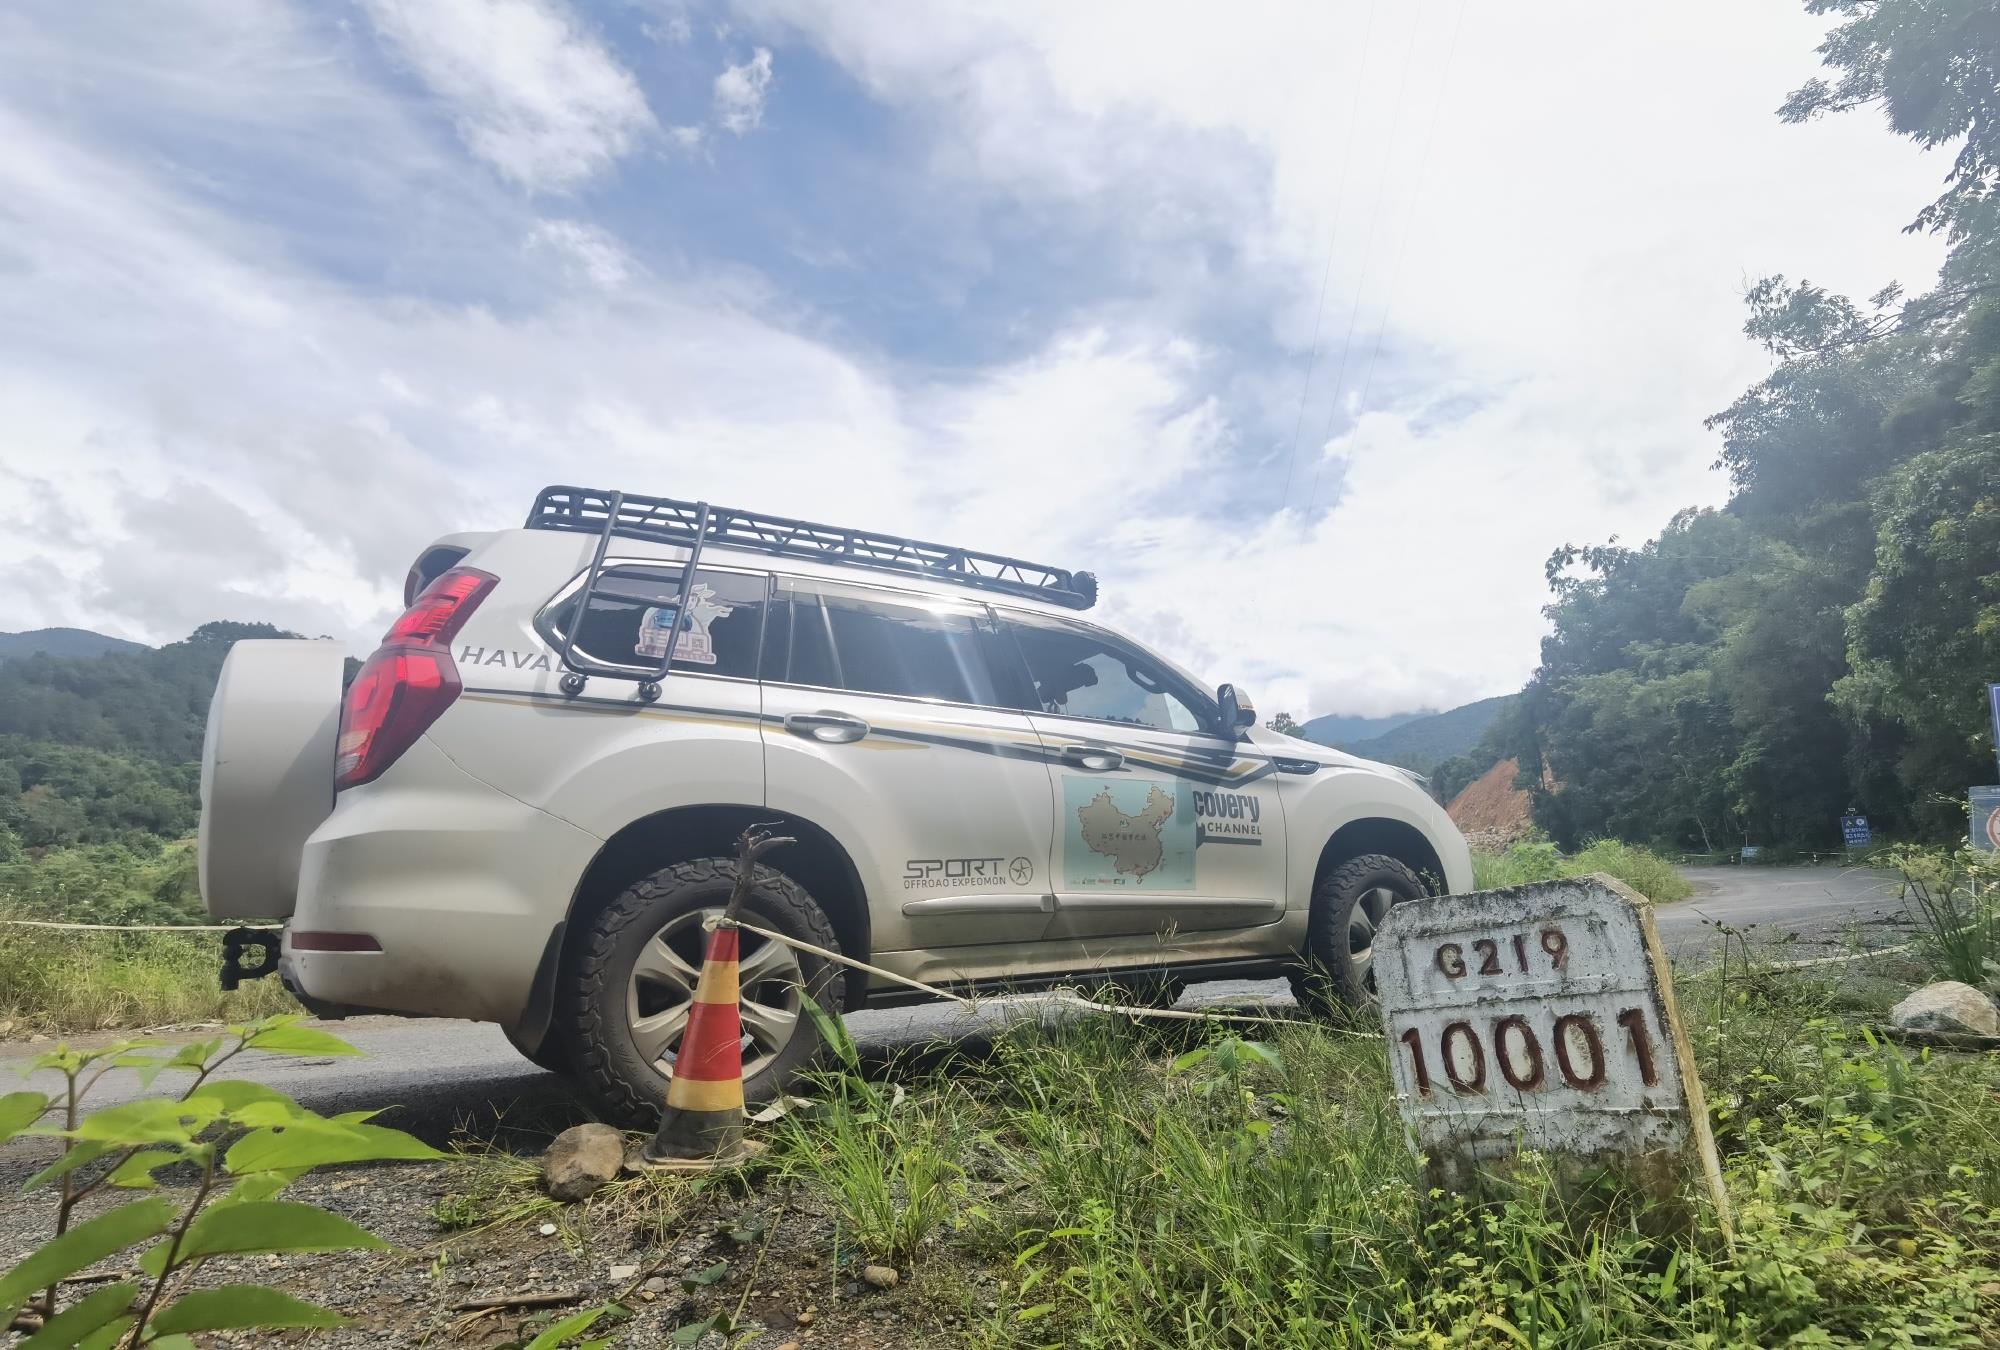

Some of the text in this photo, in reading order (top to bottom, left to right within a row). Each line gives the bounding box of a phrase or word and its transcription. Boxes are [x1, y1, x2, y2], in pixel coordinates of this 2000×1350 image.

[1207, 821, 1262, 836] CHANNEL
[903, 858, 1005, 879] SPORT
[1436, 929, 1569, 979] G219
[1401, 1008, 1658, 1098] 10001
